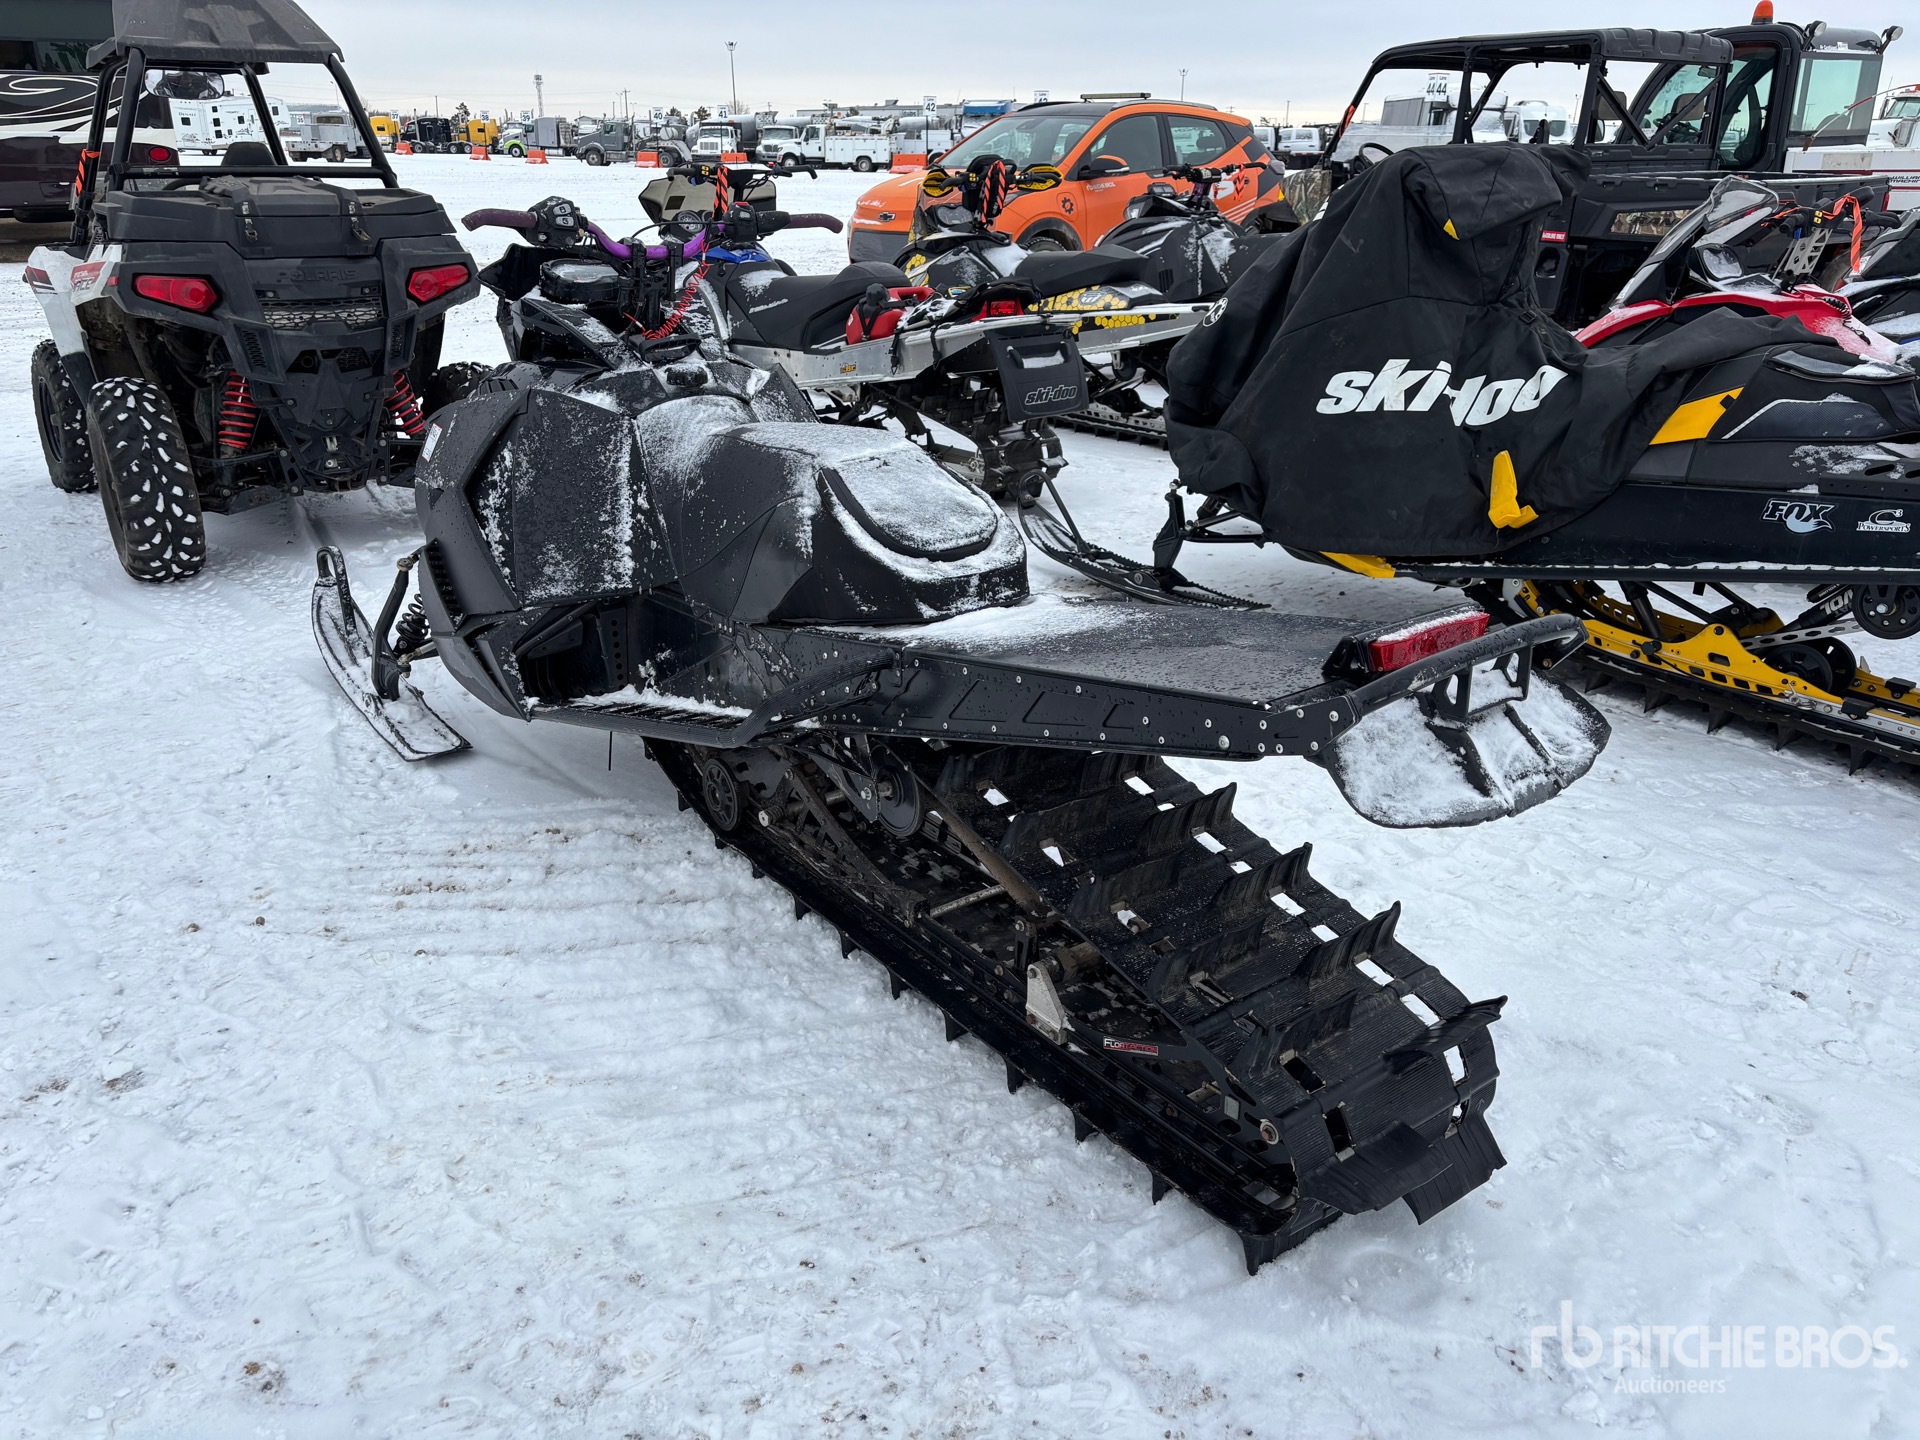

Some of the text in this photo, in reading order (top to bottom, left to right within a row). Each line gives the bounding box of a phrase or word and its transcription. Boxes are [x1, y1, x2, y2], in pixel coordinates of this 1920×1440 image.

[1436, 83, 1447, 95] 44
[926, 102, 935, 112] 42
[481, 114, 489, 122] 38
[522, 114, 530, 122] 39
[654, 112, 663, 120] 40
[719, 110, 728, 118] 41
[276, 268, 358, 283] POLARIS
[1025, 384, 1078, 405] ski-doo
[1762, 500, 1835, 524] FOX
